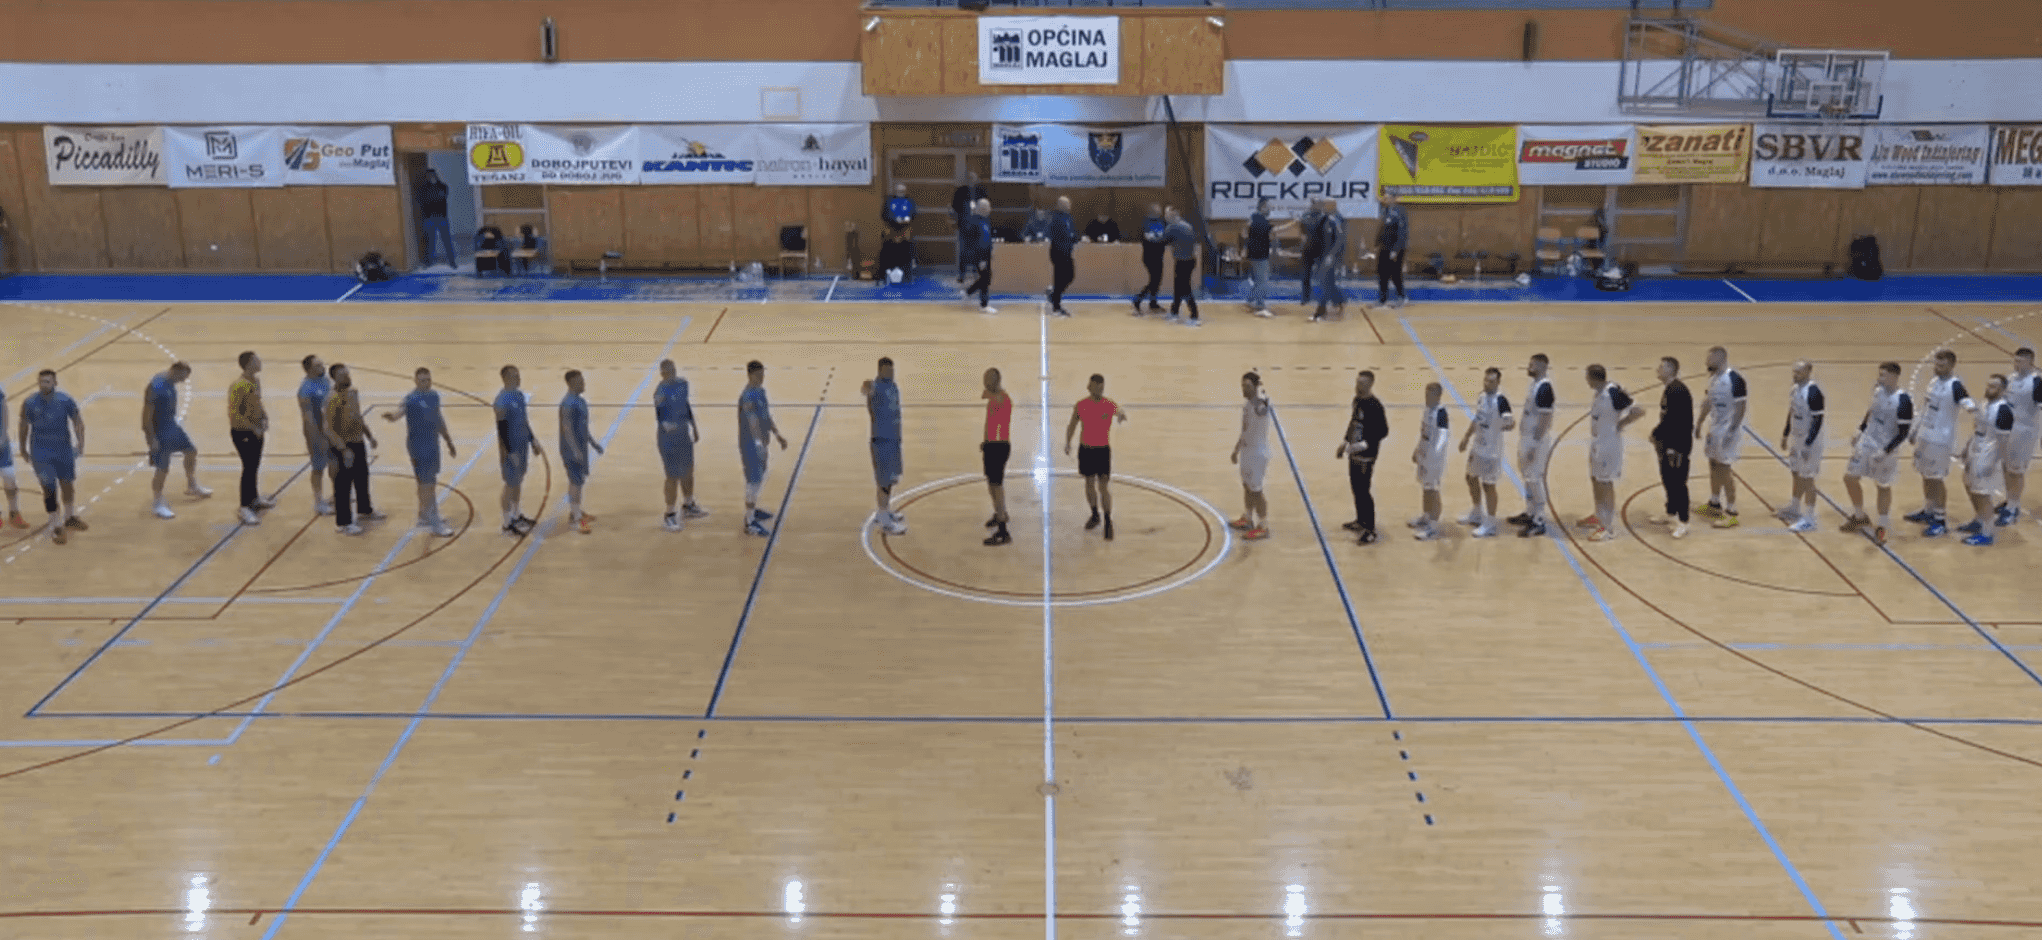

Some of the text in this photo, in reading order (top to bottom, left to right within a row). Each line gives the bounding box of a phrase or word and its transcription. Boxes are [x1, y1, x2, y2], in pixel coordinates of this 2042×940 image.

[1027, 24, 1107, 46] OPĆINA
[1026, 51, 1108, 68] MAGLAJ
[321, 143, 390, 158] Geo Put
[1528, 142, 1617, 158] magnet
[1755, 133, 1862, 161] SBVR
[53, 135, 160, 178] Piccadilly
[1583, 159, 1622, 169] STUDIO
[186, 163, 265, 179] MERI-S
[1804, 166, 1846, 179] Maglaj
[1211, 181, 1370, 200] ROCKPUR
